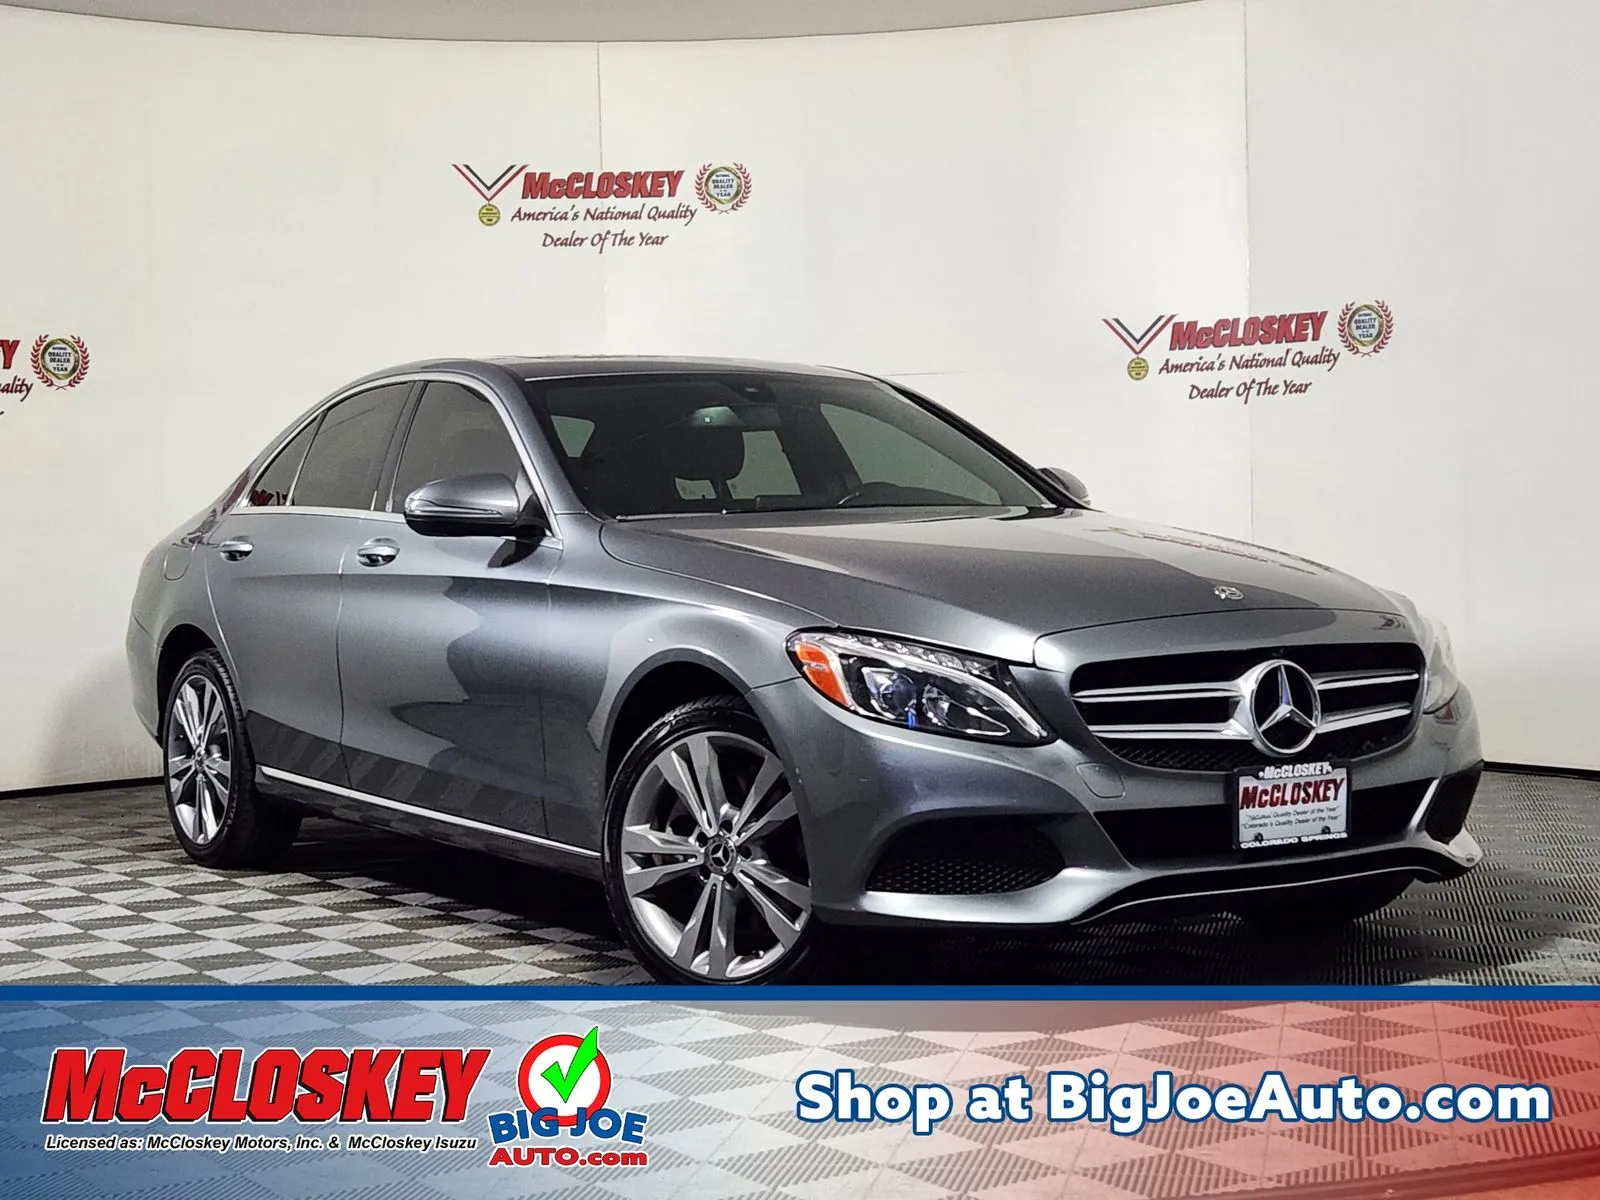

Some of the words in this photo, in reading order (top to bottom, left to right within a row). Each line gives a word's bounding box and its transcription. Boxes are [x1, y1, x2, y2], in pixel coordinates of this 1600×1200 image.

[521, 170, 685, 200] McCLOSKEY
[511, 204, 580, 222] America's
[583, 204, 642, 222] National
[647, 203, 698, 227] Quality
[541, 231, 588, 248] Dealer
[590, 230, 613, 254] Of
[611, 231, 635, 246] The
[637, 231, 669, 247] Year
[1169, 310, 1329, 351] McCLOSKEY
[1158, 353, 1226, 375] America's
[1229, 348, 1288, 371] National
[1291, 346, 1341, 372] Quality
[0, 375, 34, 402] ality
[1188, 379, 1234, 400] Dealer
[1235, 378, 1258, 405] Of
[1256, 378, 1279, 396] The
[1282, 382, 1313, 396] Year
[1239, 778, 1346, 810] McCLOSKEY
[1240, 837, 1298, 849] COLORADO
[1301, 832, 1348, 843] SPRINGS
